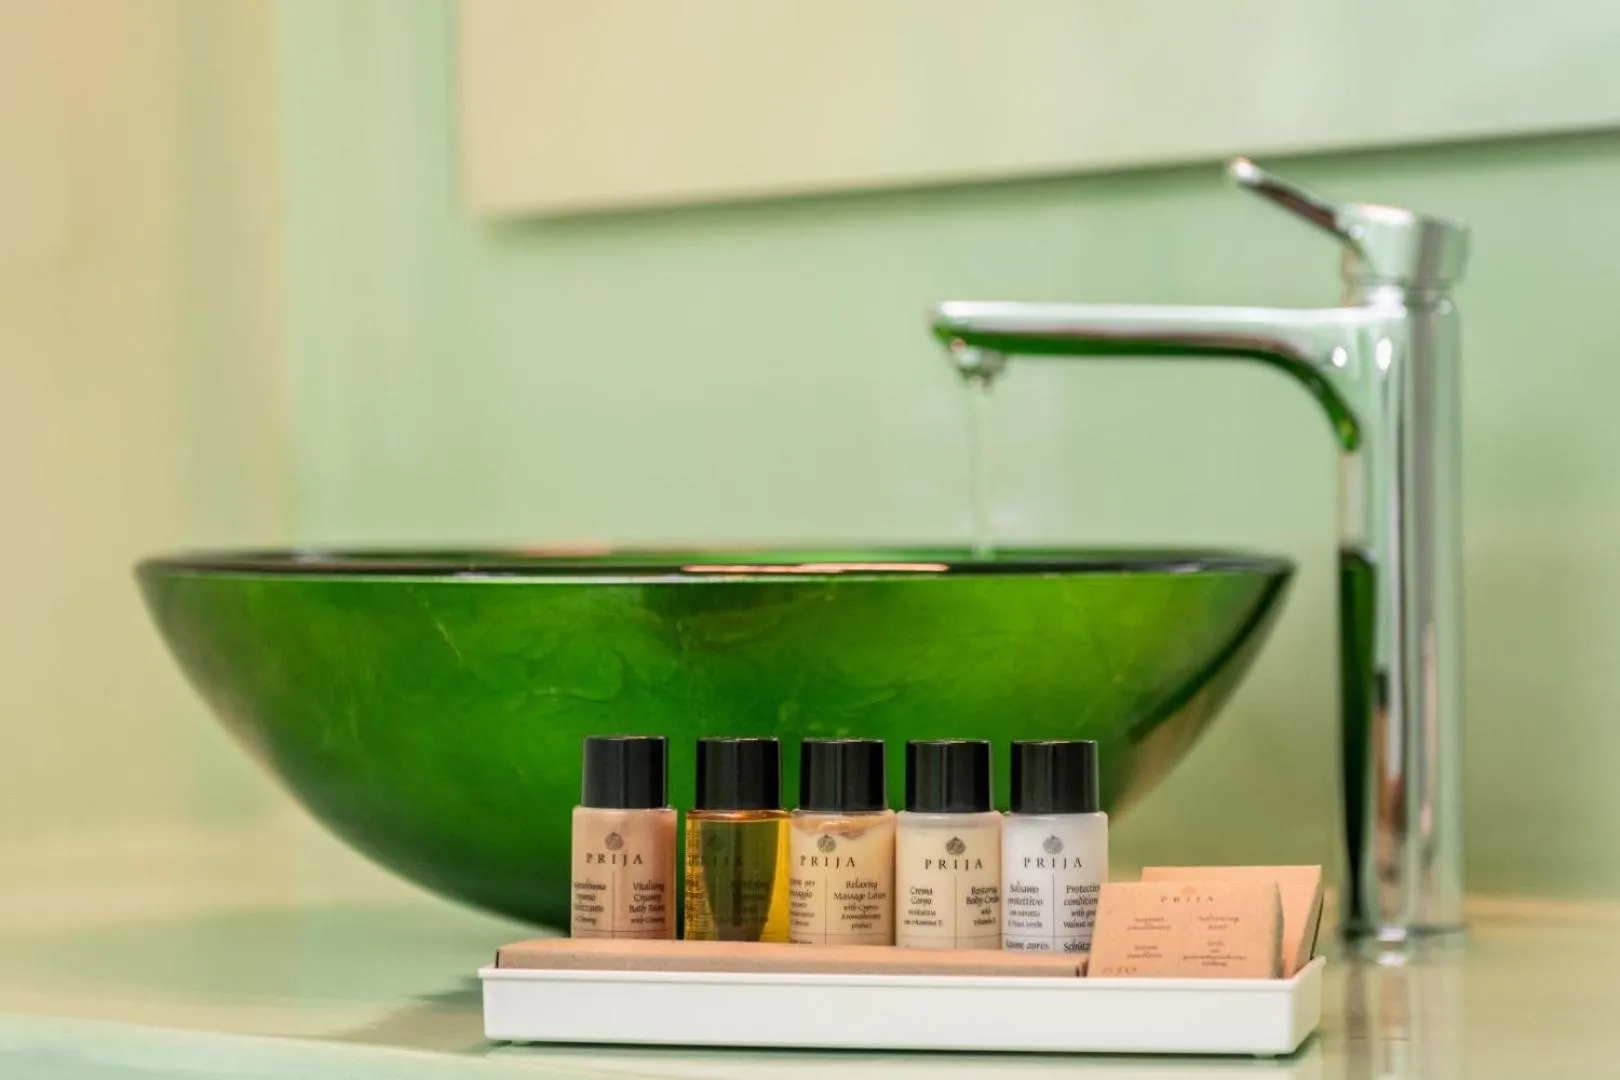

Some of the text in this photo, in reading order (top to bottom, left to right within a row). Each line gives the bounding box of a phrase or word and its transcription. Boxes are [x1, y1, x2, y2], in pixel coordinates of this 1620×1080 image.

[585, 852, 643, 867] PRIJA
[799, 855, 856, 870] PRIJA
[924, 858, 983, 873] PRIJA
[1023, 856, 1083, 870] PRIJA
